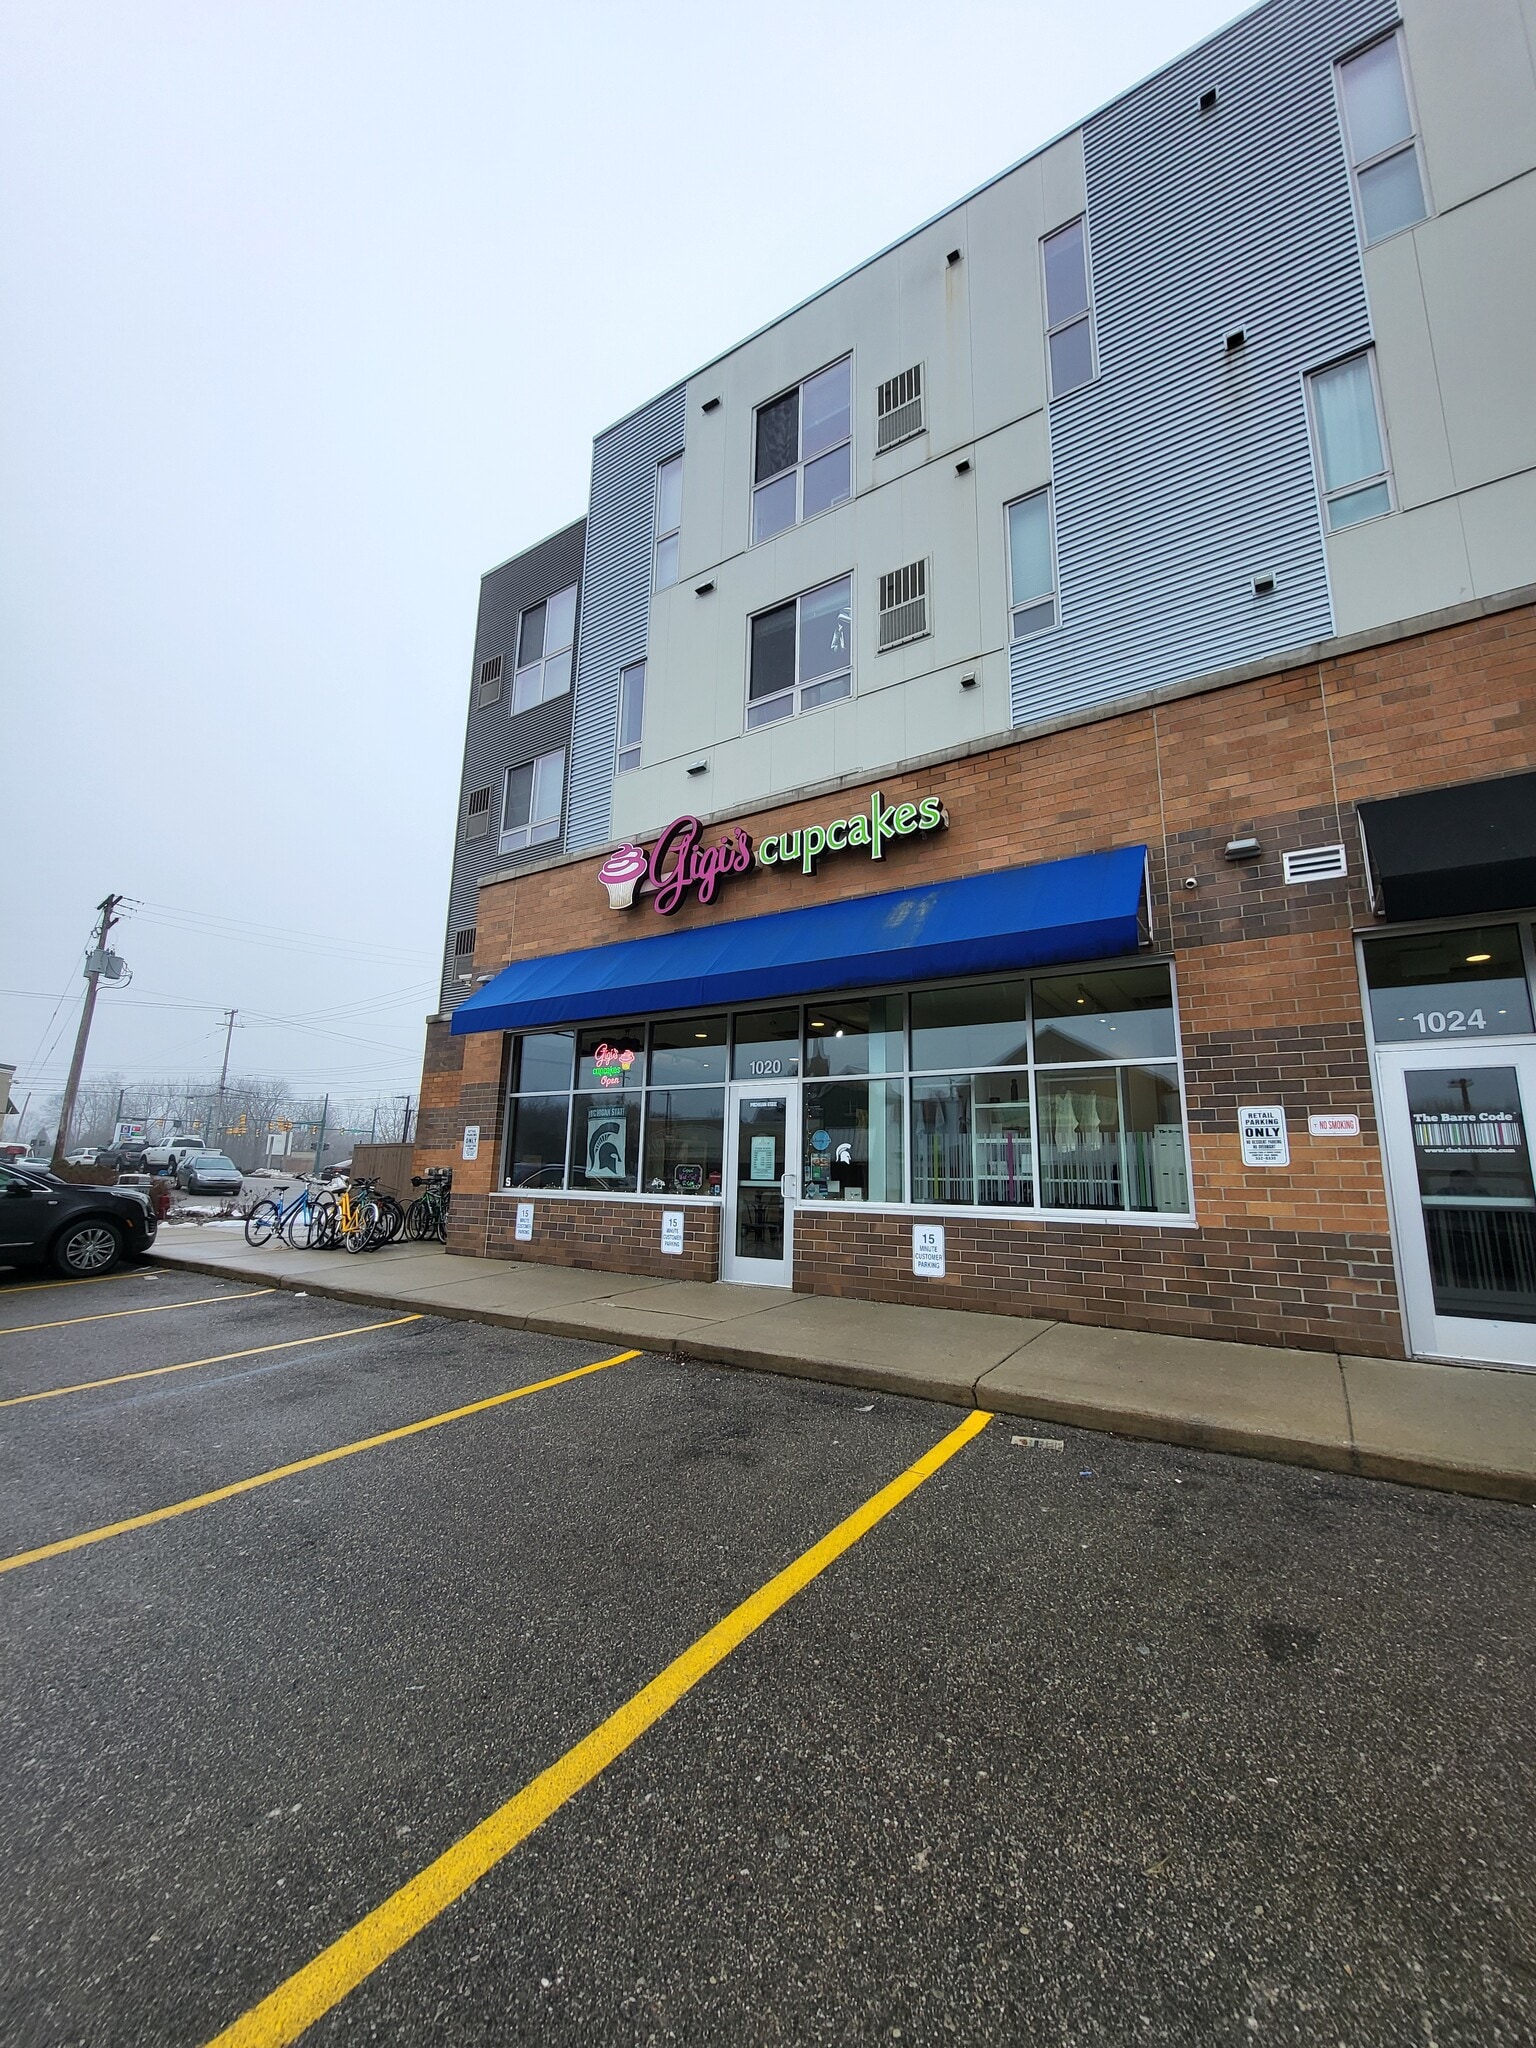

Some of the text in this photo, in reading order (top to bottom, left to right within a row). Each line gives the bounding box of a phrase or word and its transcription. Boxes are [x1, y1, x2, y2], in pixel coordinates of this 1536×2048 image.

[650, 790, 941, 915] Gigi's cupcakes
[1412, 1008, 1487, 1033] 1024
[750, 1059, 781, 1075] 1020
[600, 1076, 620, 1088] Open
[1413, 1112, 1513, 1122] The Barre Code
[1319, 1120, 1355, 1130] NO SMOKING
[1245, 1127, 1280, 1138] ONLY
[521, 1209, 529, 1217] 15
[668, 1218, 678, 1227] 15
[922, 1233, 935, 1244] 15
[919, 1245, 938, 1253] MINUTE
[915, 1252, 942, 1261] CUSTOMER
[917, 1260, 940, 1269] PARKING
